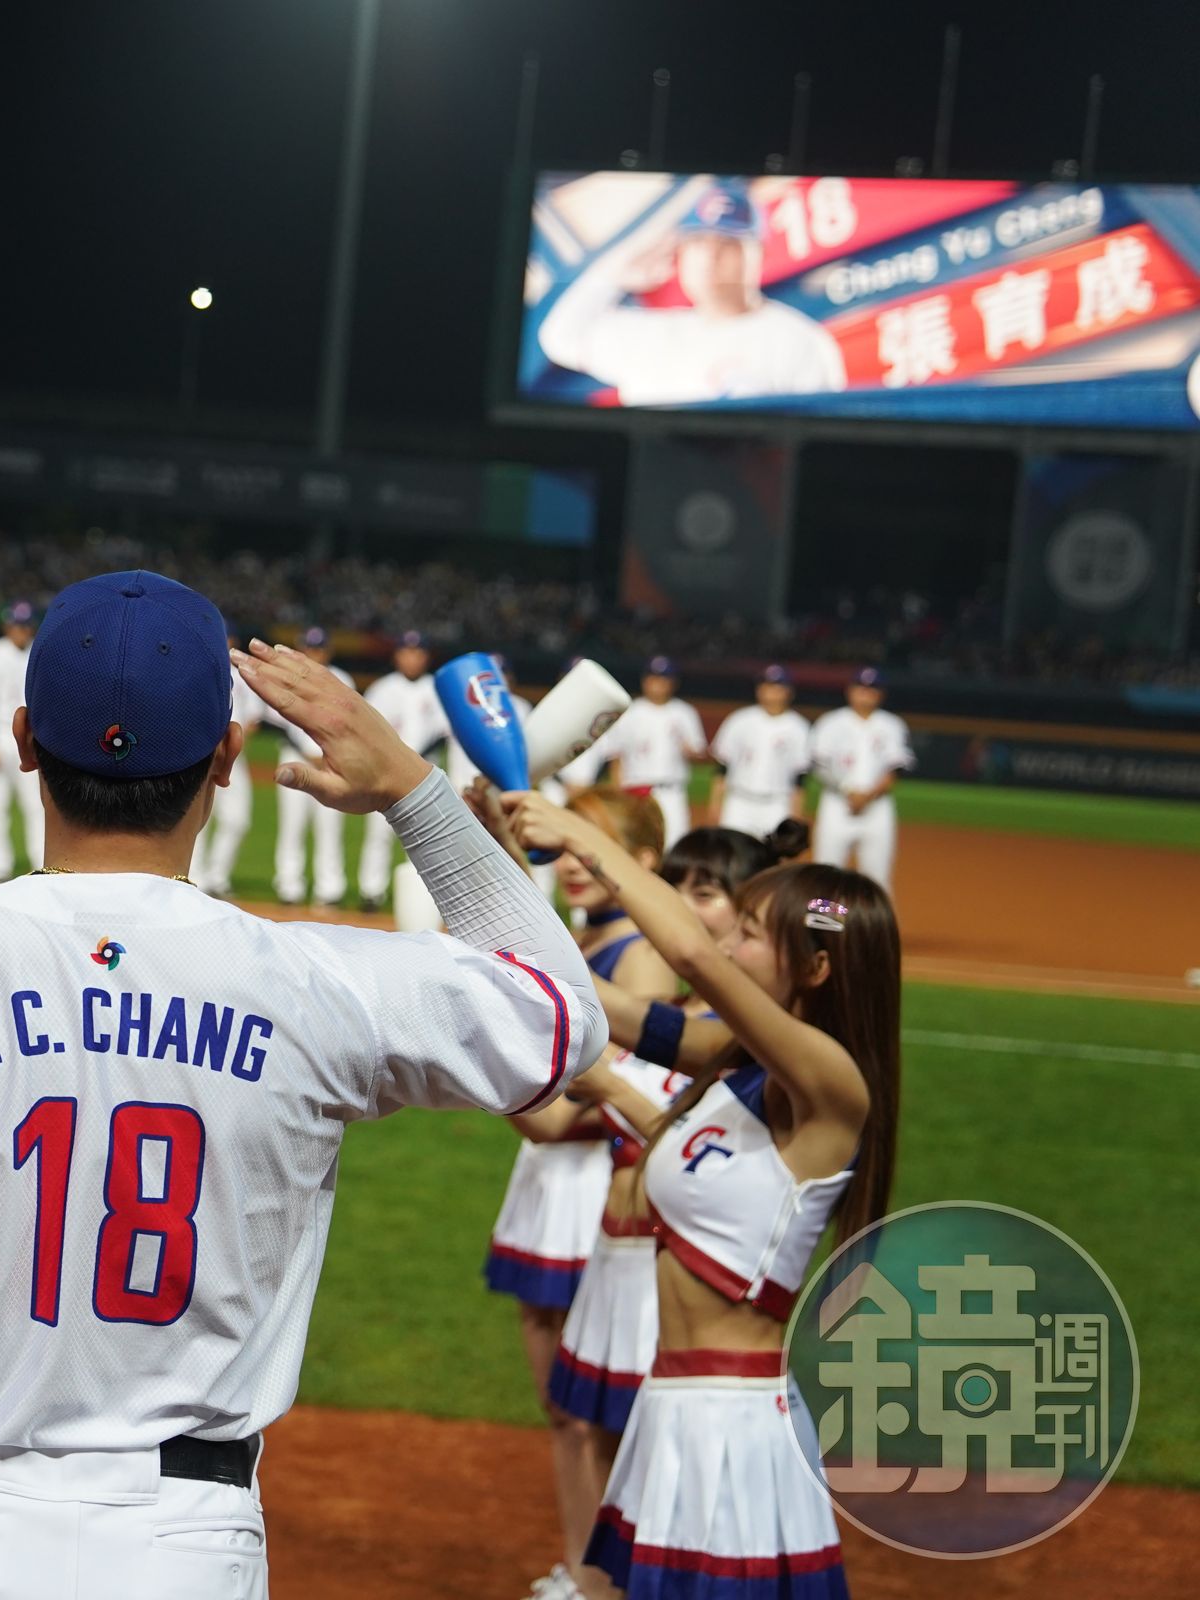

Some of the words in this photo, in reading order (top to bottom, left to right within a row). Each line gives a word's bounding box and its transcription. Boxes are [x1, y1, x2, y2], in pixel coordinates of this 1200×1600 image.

[772, 177, 856, 259] 18
[11, 990, 66, 1057] C.
[82, 987, 274, 1082] CHANG
[13, 1096, 206, 1327] 18
